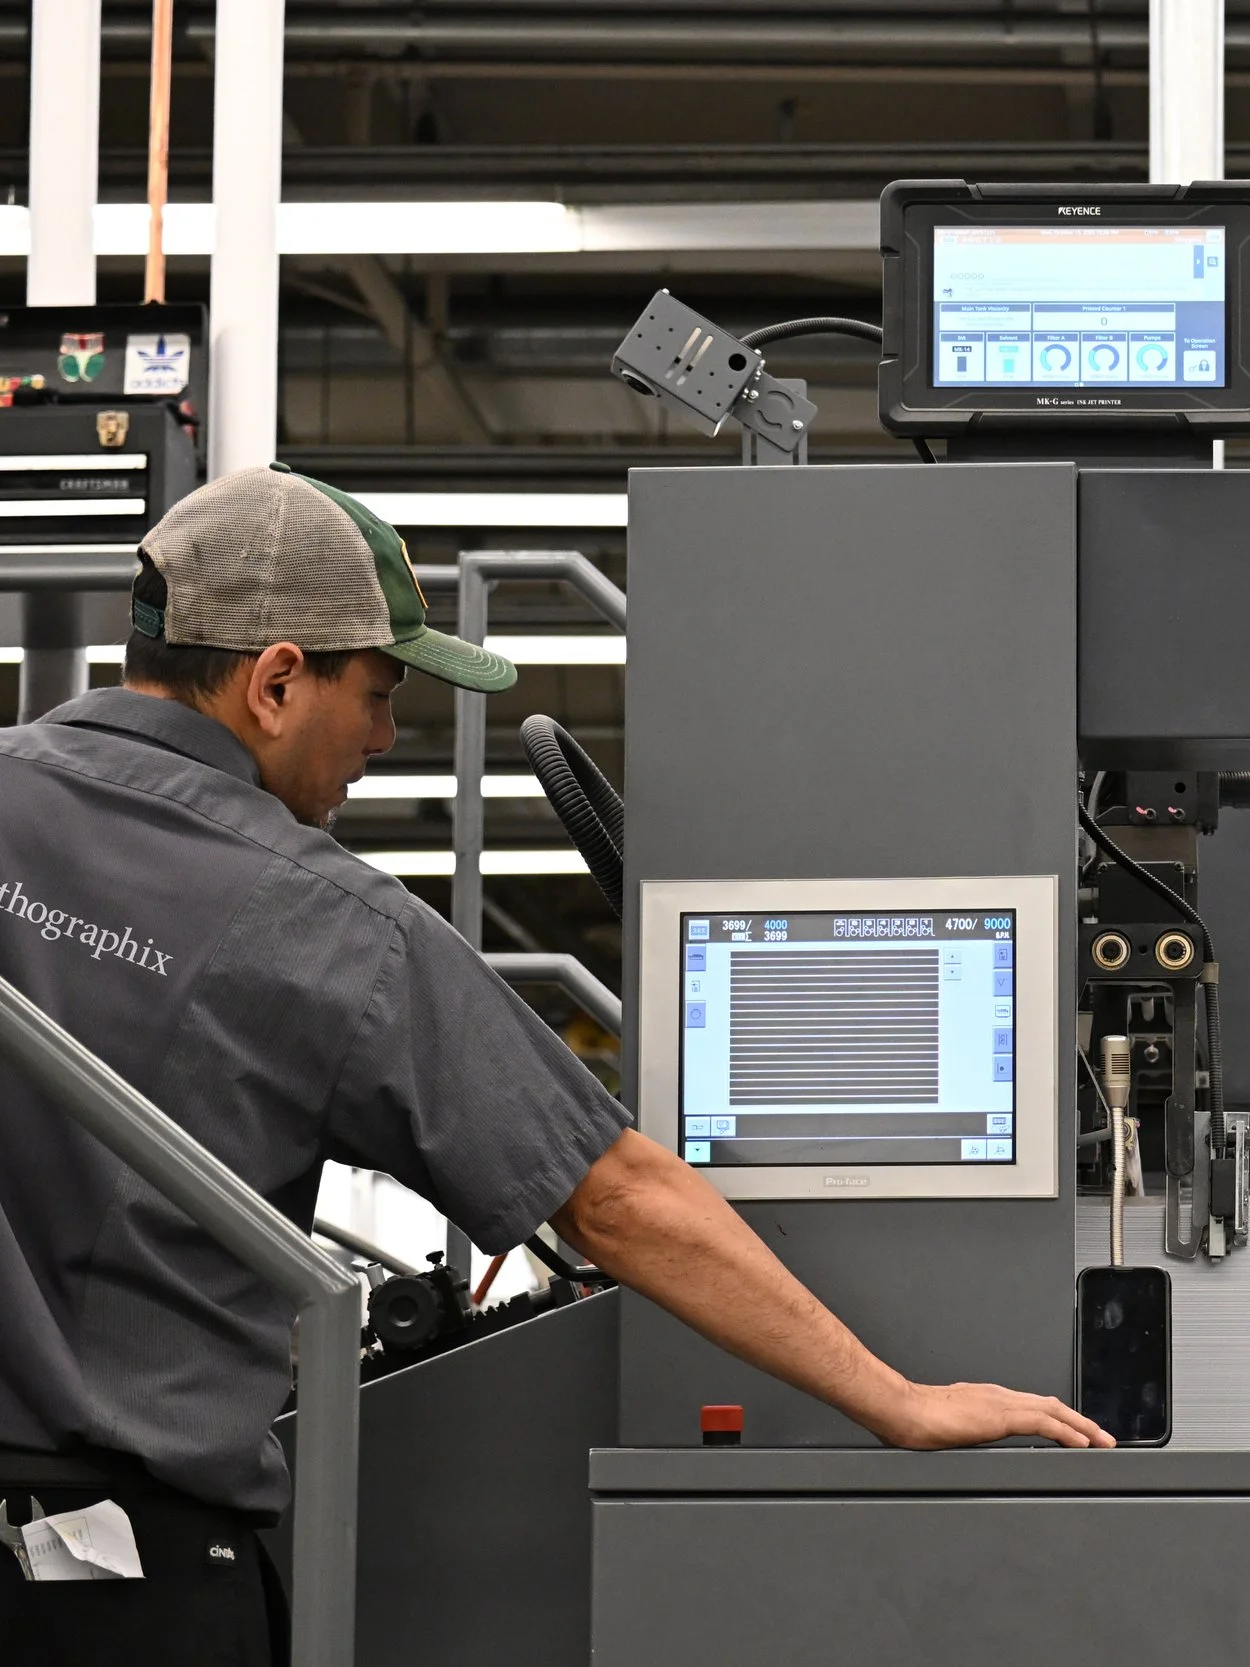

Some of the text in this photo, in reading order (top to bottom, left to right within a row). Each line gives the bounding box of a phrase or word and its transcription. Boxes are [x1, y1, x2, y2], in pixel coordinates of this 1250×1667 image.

[1058, 206, 1101, 216] KEYENCE
[1036, 397, 1059, 405] MK-G
[764, 919, 788, 930] 4000
[983, 917, 1011, 930] 9000
[764, 931, 788, 941] 3699
